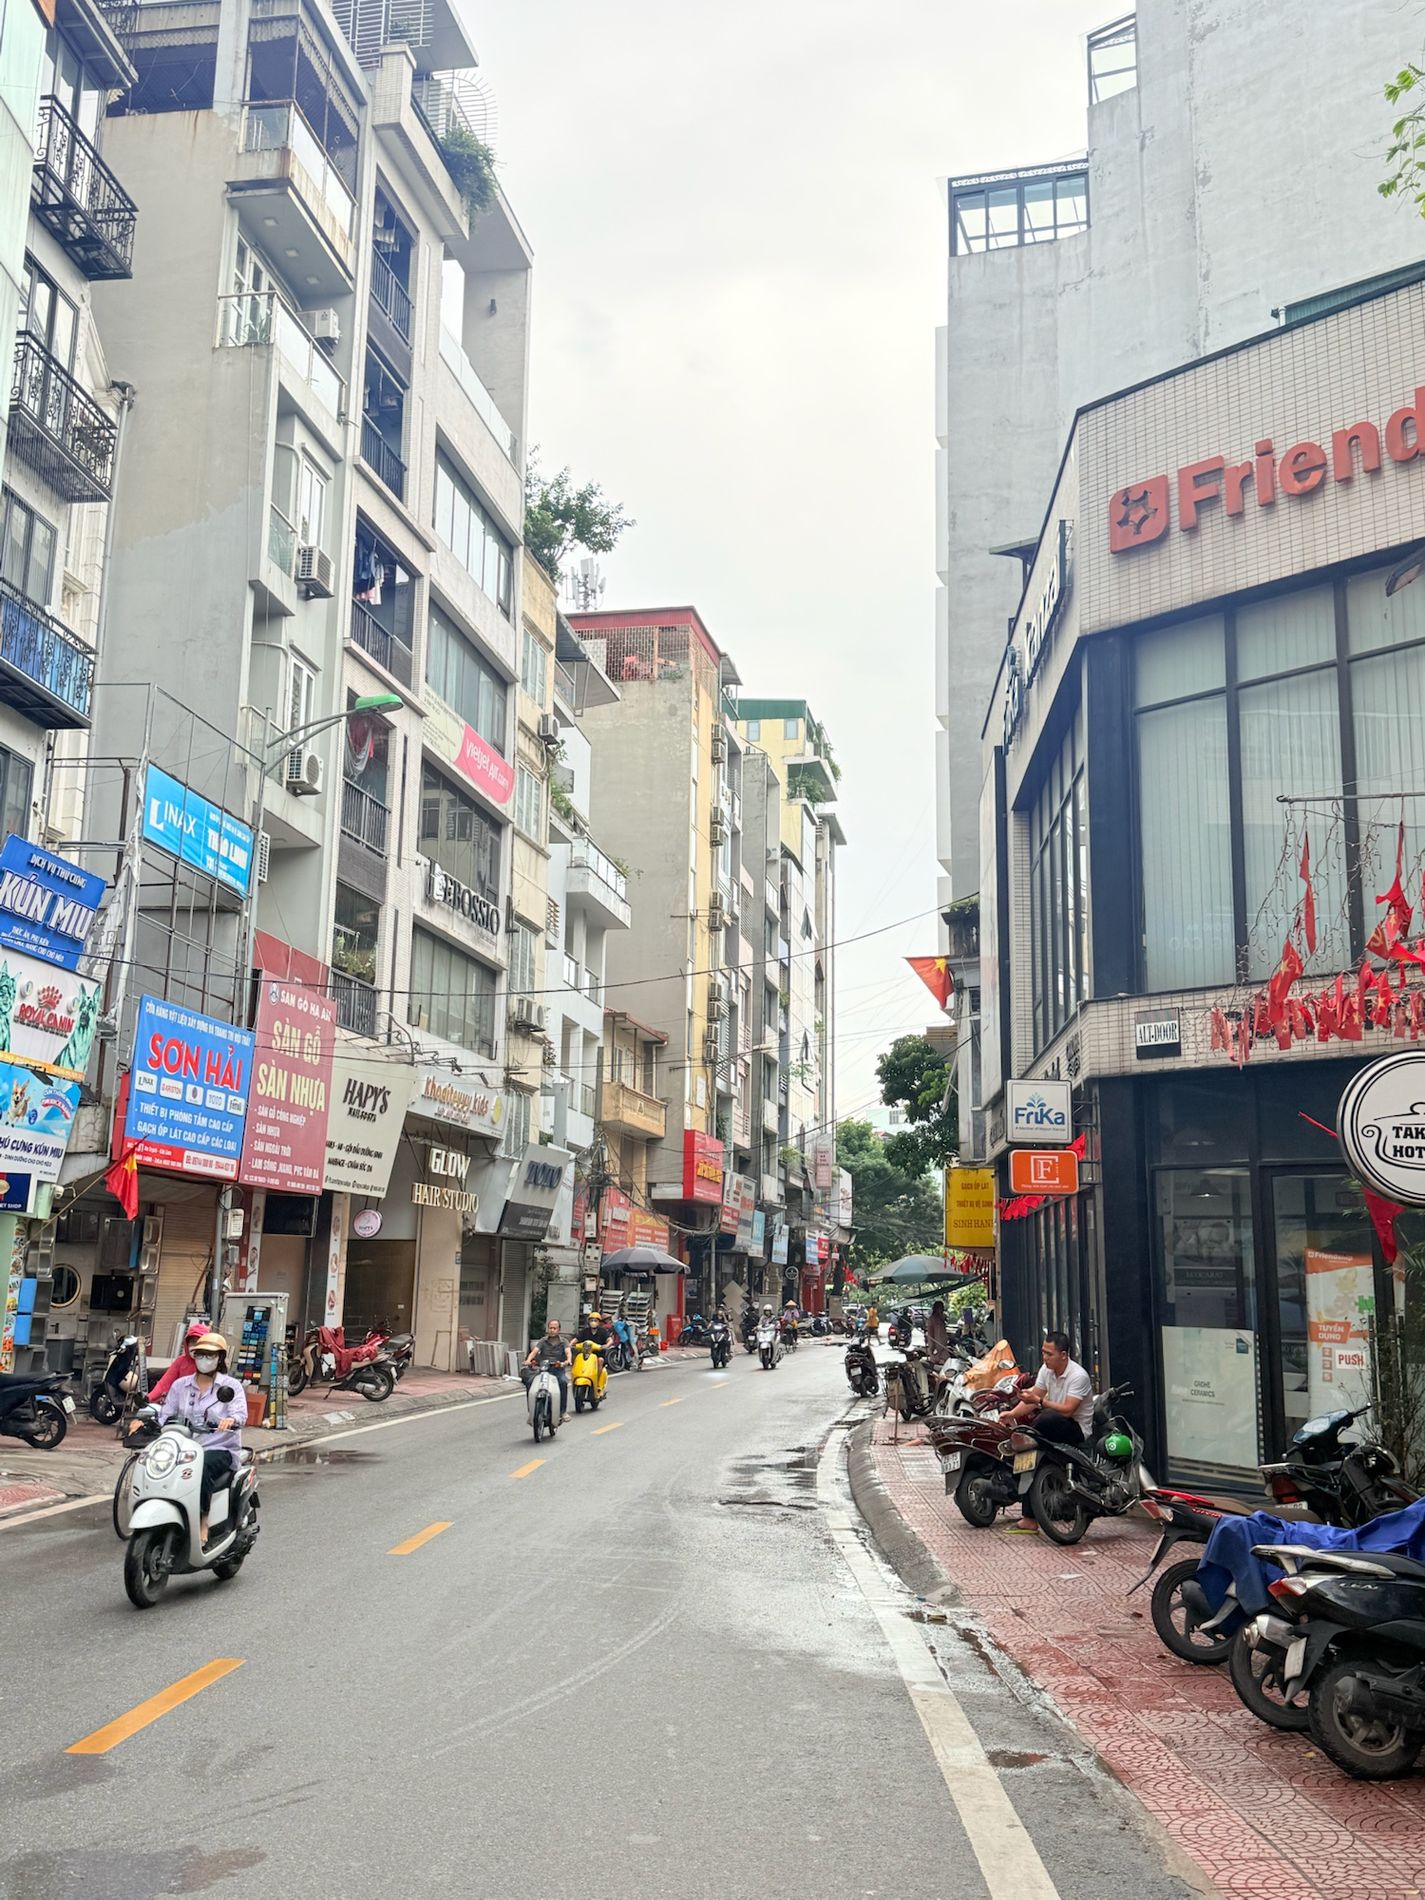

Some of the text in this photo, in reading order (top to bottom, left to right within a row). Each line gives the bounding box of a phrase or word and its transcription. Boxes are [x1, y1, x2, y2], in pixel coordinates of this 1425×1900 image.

[1177, 385, 1425, 533] Friend
[0, 872, 96, 942] KÚN MIU
[18, 1003, 46, 1026] ROYAL
[46, 1012, 75, 1033] CANIN
[272, 1017, 321, 1066] SÀN GỖ
[147, 1032, 243, 1092] SƠN HẢI
[257, 1059, 326, 1116] SÀN NHỰA
[343, 1078, 391, 1115] HAPY'S
[140, 1102, 159, 1116] THIẾT
[160, 1107, 168, 1121] BỊ
[208, 1118, 221, 1130] CAO
[221, 1118, 233, 1133] CẤP
[472, 1092, 489, 1117] kids
[1015, 1107, 1065, 1125] FriKa
[137, 1121, 156, 1137] GẠCH
[158, 1122, 168, 1136] ỐP
[169, 1126, 182, 1141] LÁT
[182, 1131, 197, 1144] CAO
[197, 1131, 211, 1146] CẤP
[11, 1139, 33, 1153] CƯNG
[33, 1142, 50, 1157] KÚN
[50, 1146, 64, 1160] MIU
[430, 1147, 471, 1179] GLOW
[1393, 1145, 1425, 1159] HOT
[413, 1182, 441, 1207] HAIR
[442, 1188, 479, 1214] STUDIO
[1338, 1354, 1364, 1366] PUSH
